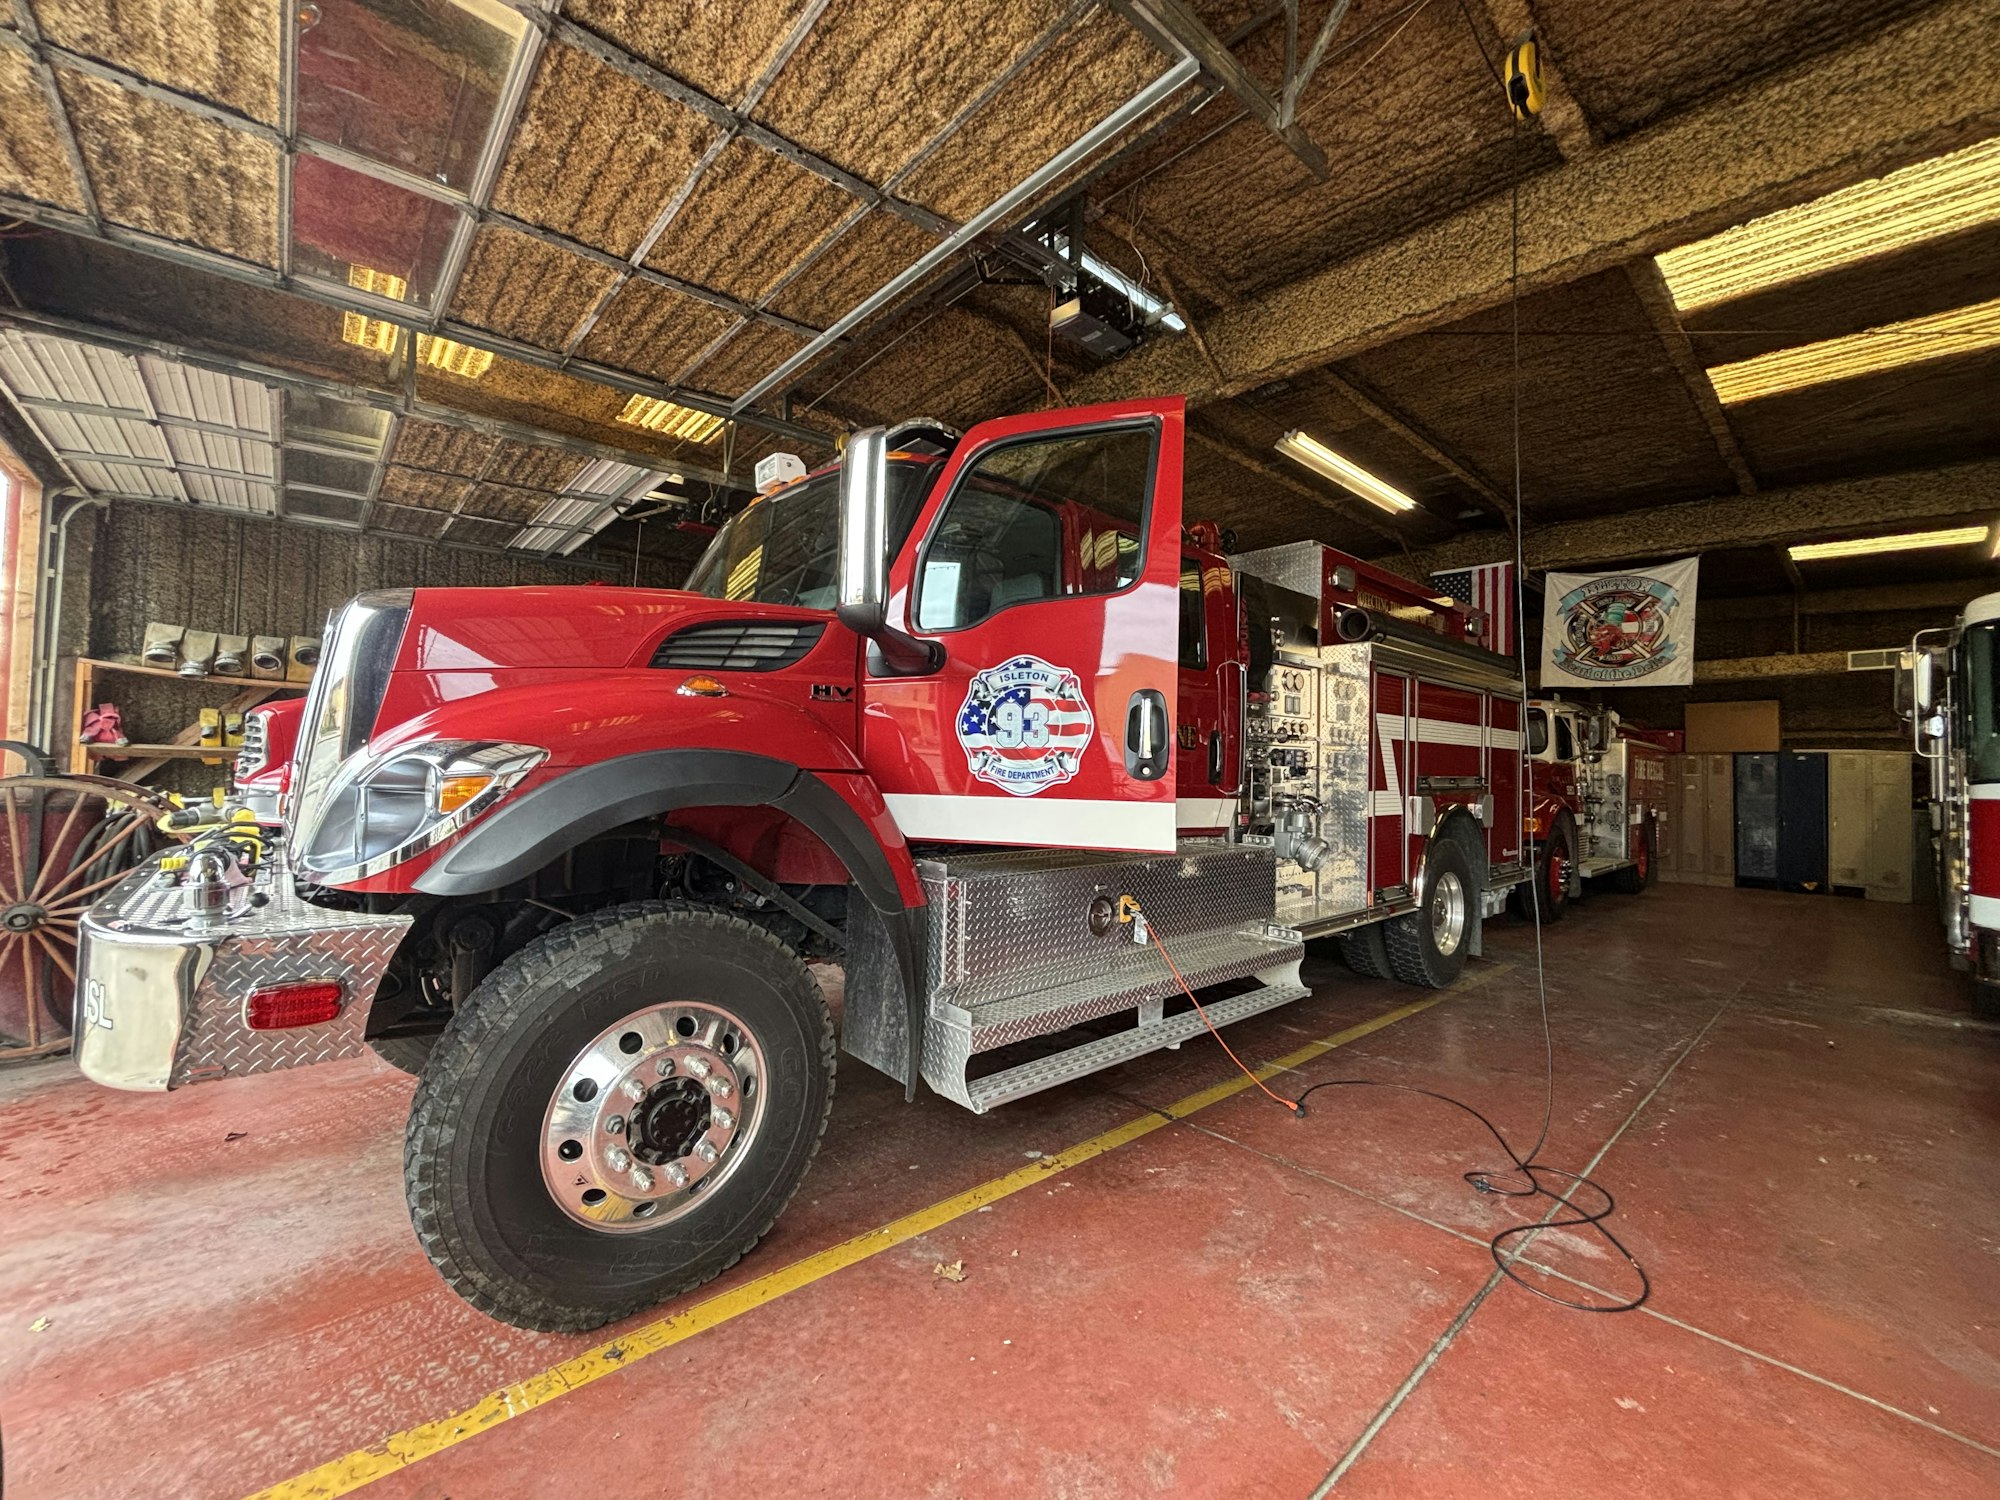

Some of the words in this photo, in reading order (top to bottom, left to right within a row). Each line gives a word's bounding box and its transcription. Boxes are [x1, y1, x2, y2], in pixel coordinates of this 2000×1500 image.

[1582, 577, 1654, 597] ISLETON
[1000, 671, 1050, 683] ISLETON
[1595, 669, 1608, 679] of
[1610, 669, 1630, 679] the
[811, 684, 854, 697] HV
[996, 701, 1049, 749] 93
[990, 766, 1006, 777] FIRE
[1007, 766, 1055, 779] DEPARTMENT
[83, 978, 113, 1030] ISL
